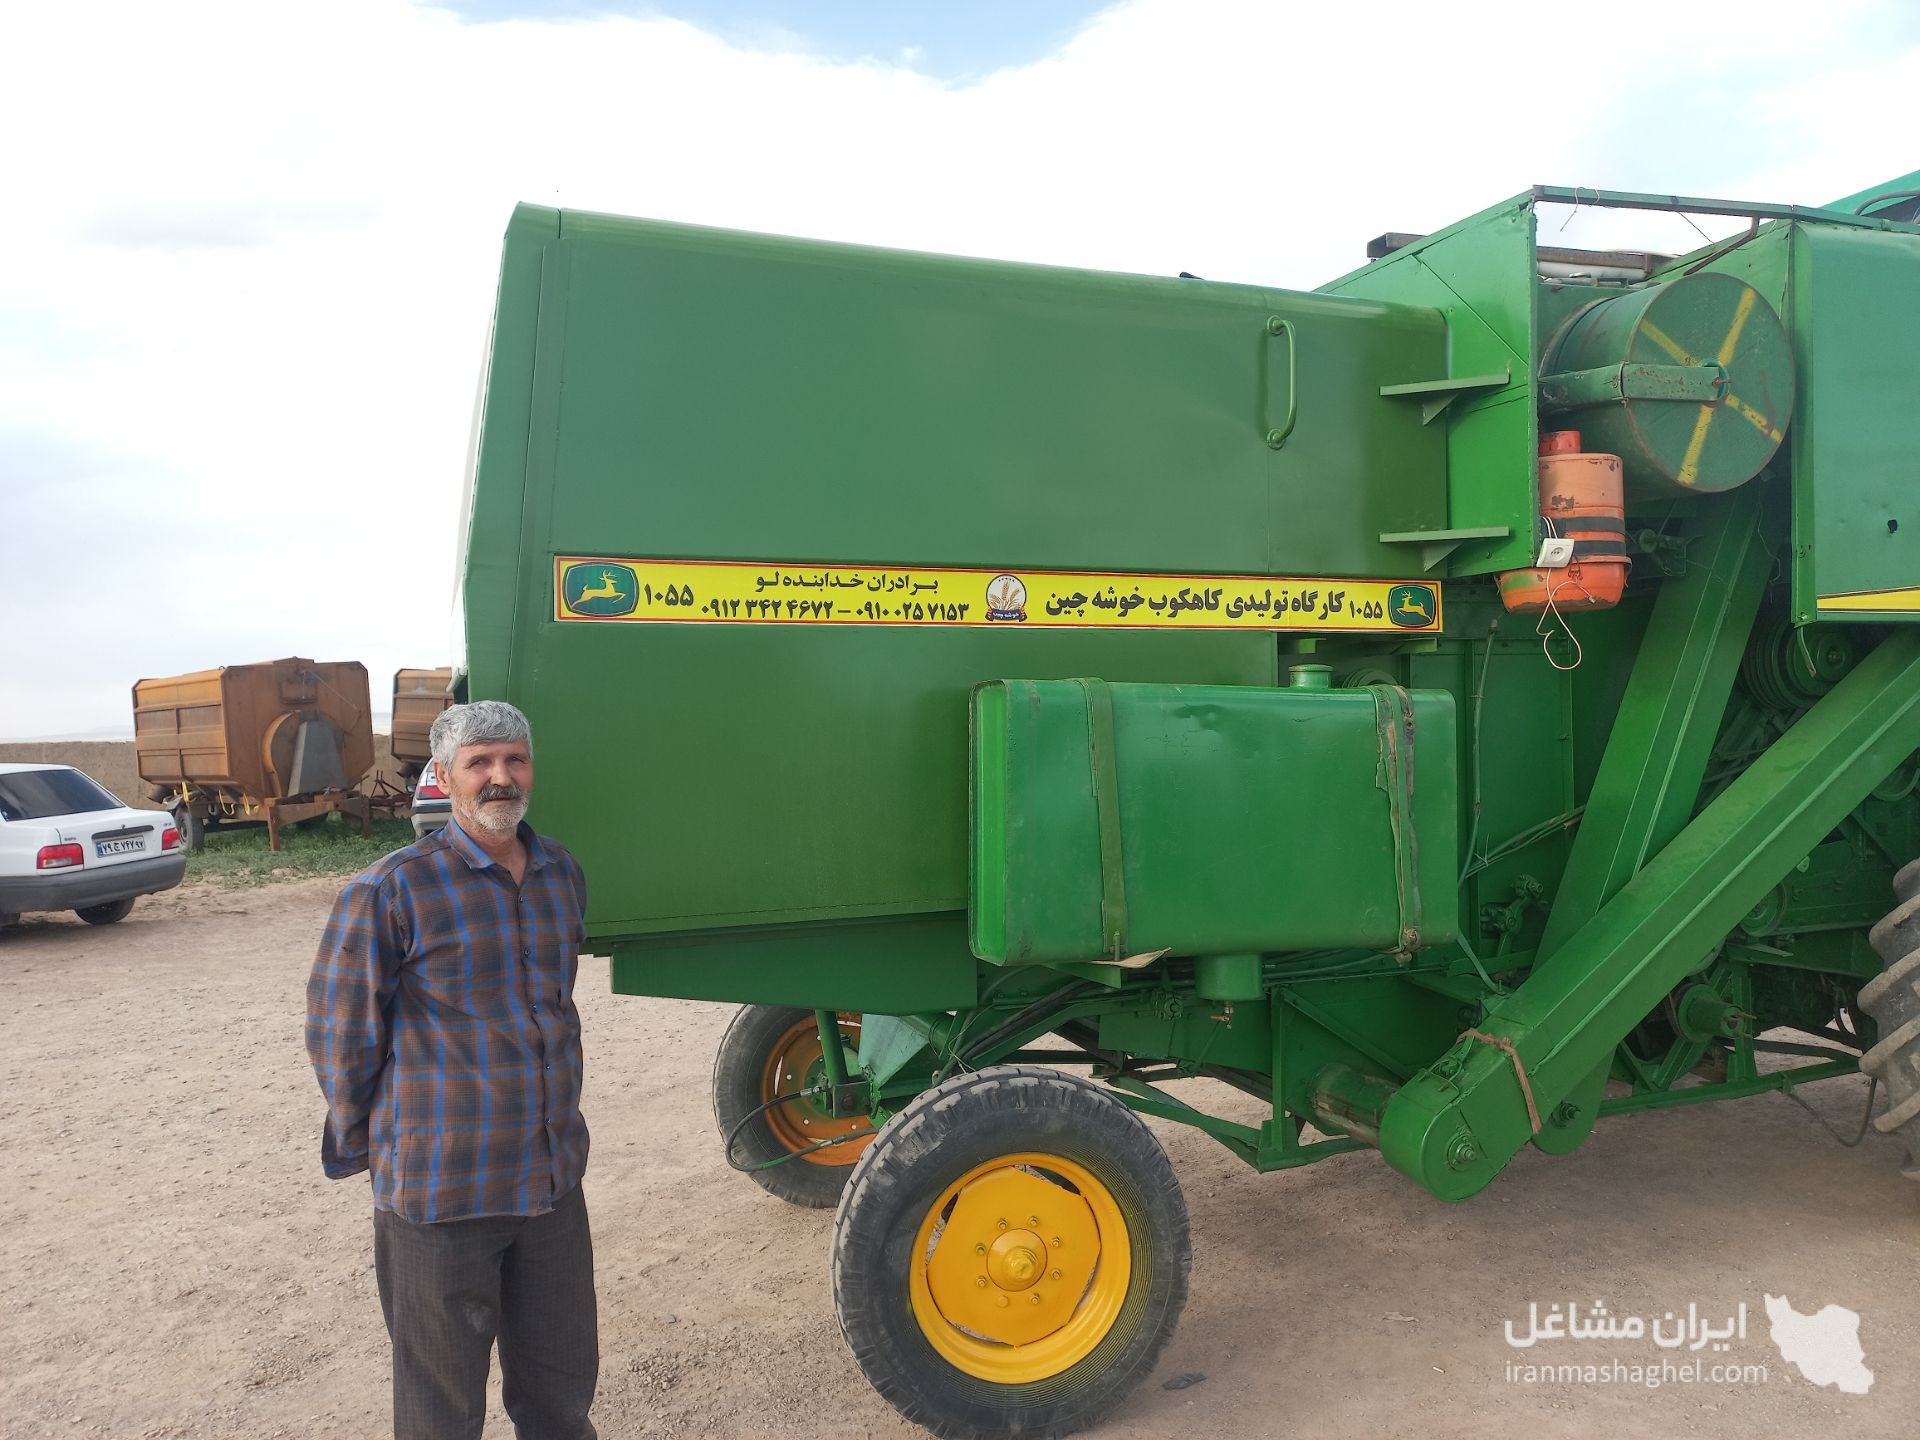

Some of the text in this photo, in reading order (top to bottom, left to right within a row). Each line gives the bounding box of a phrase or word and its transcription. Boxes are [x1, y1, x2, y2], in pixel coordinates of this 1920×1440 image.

[644, 583, 694, 607] ۱۰۵۵
[868, 573, 938, 595] برادران
[1045, 591, 1089, 617] چین
[1092, 586, 1146, 617] خوشه
[1148, 587, 1223, 618] کاهکوب
[1226, 588, 1289, 619] تولیدی
[1349, 600, 1383, 619] ۱۰۵۵
